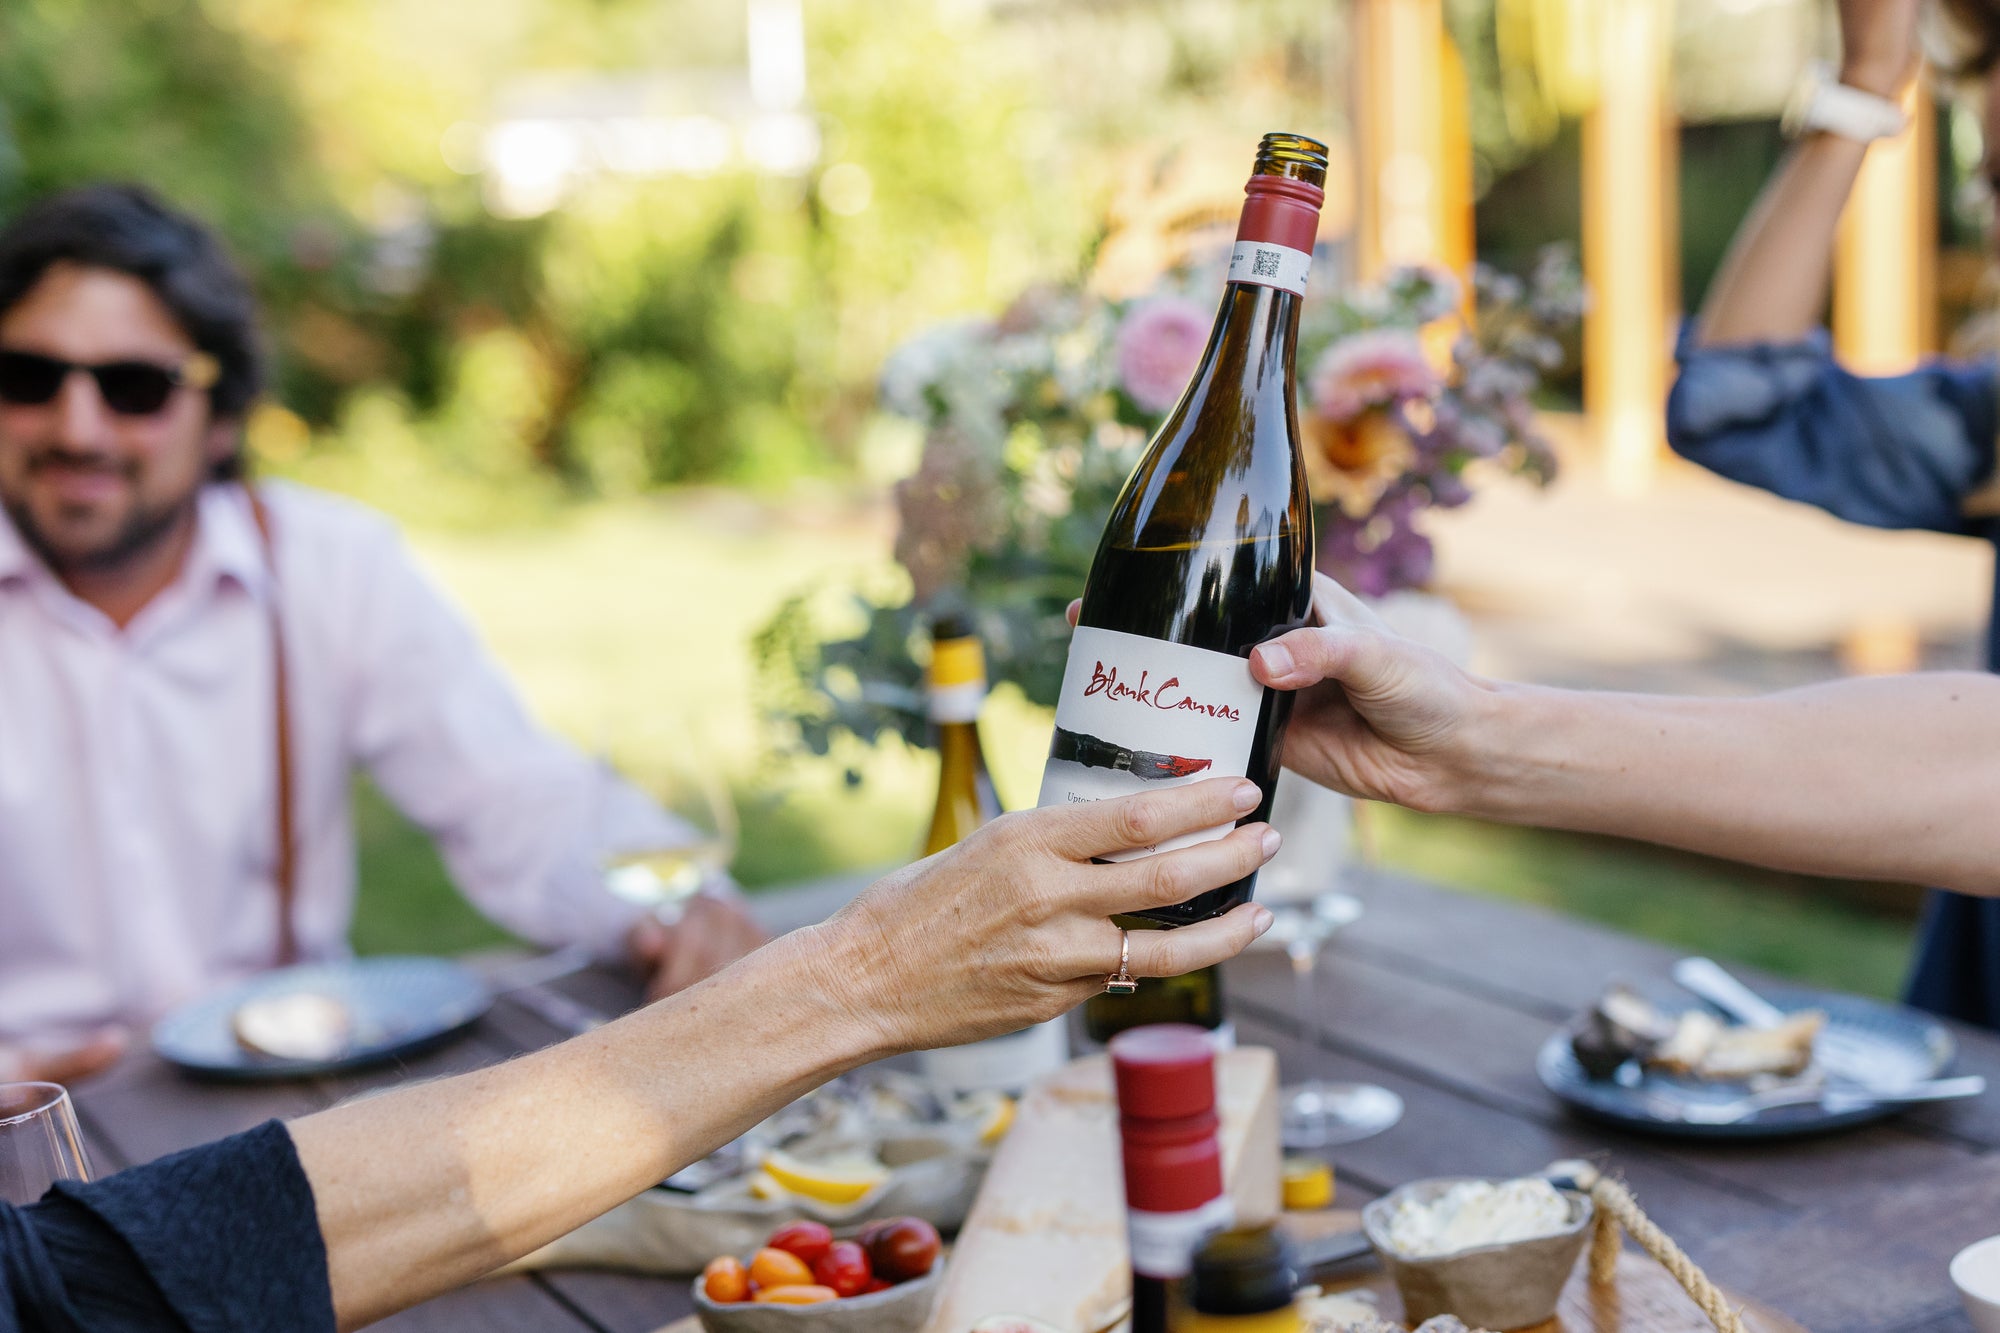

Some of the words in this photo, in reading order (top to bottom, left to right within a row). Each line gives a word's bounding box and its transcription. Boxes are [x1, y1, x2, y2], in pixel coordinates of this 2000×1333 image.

[1084, 660, 1153, 708] Blank
[1154, 677, 1240, 722] Canvas
[1067, 791, 1092, 803] Upto
